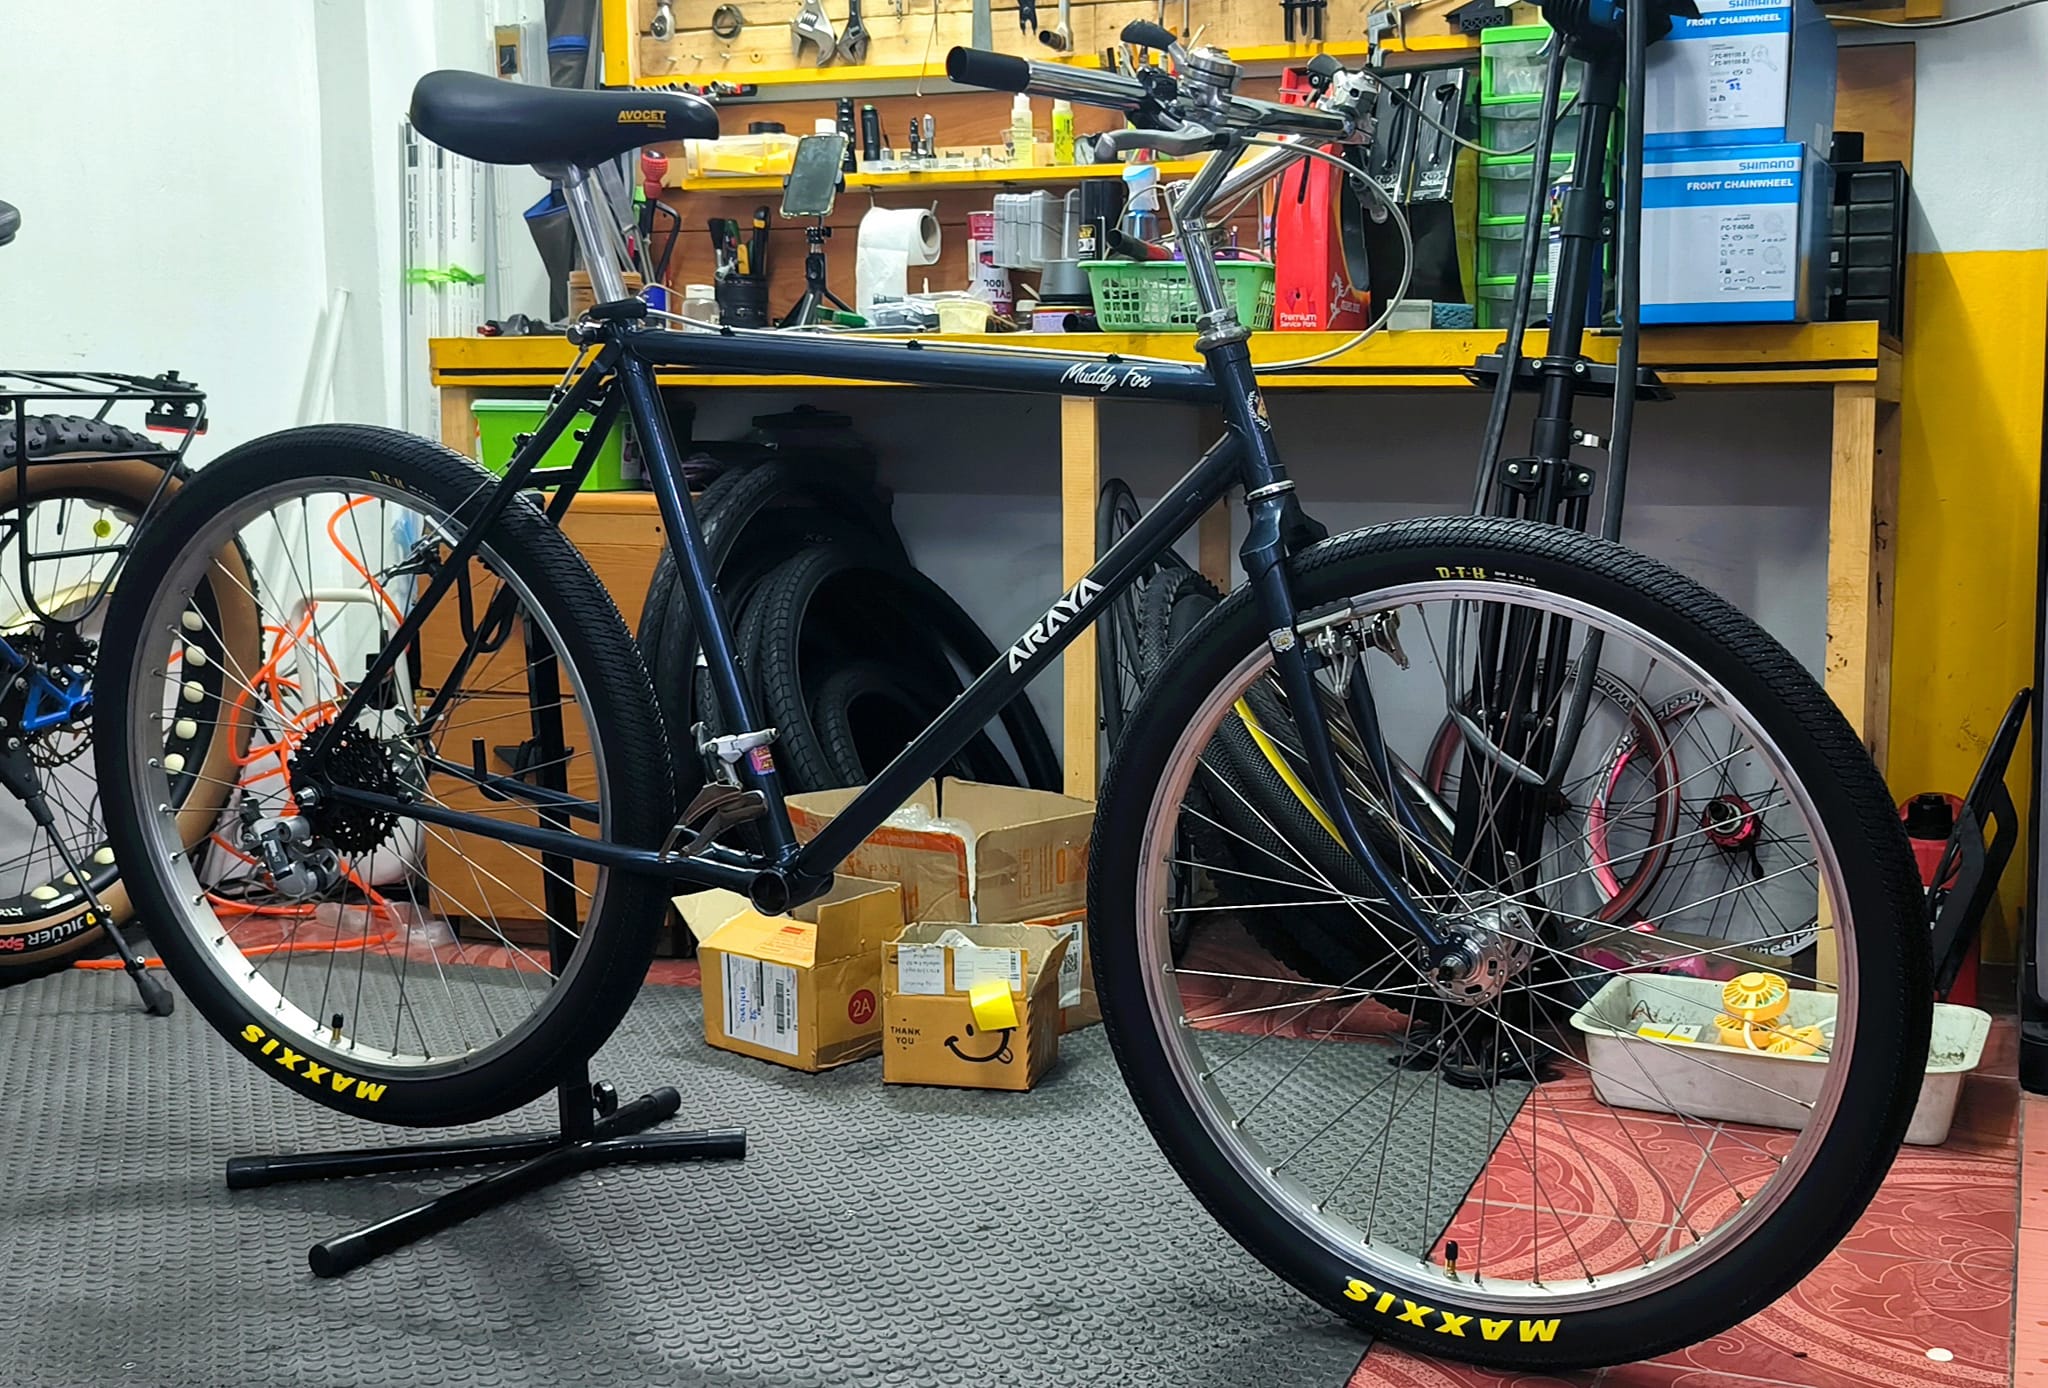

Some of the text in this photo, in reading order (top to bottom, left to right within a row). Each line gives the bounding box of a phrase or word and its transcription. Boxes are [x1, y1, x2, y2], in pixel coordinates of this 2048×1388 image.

[1729, 0, 1782, 8] SHIMANO
[1686, 13, 1782, 27] FRONT CHAINWHEEL
[618, 110, 667, 121] AVOCET
[1739, 160, 1795, 171] SHIMANO
[1687, 178, 1794, 191] FRONT CHAINWHEEL
[1280, 313, 1317, 321] Premium
[1060, 362, 1152, 392] Muddy Fox
[1008, 577, 1104, 674] ARAYA
[853, 998, 872, 1017] 2A
[890, 1026, 921, 1036] THANK
[896, 1036, 914, 1045] YOU
[240, 1024, 387, 1102] MAXXIS
[1342, 1277, 1562, 1342] MAXXIS
